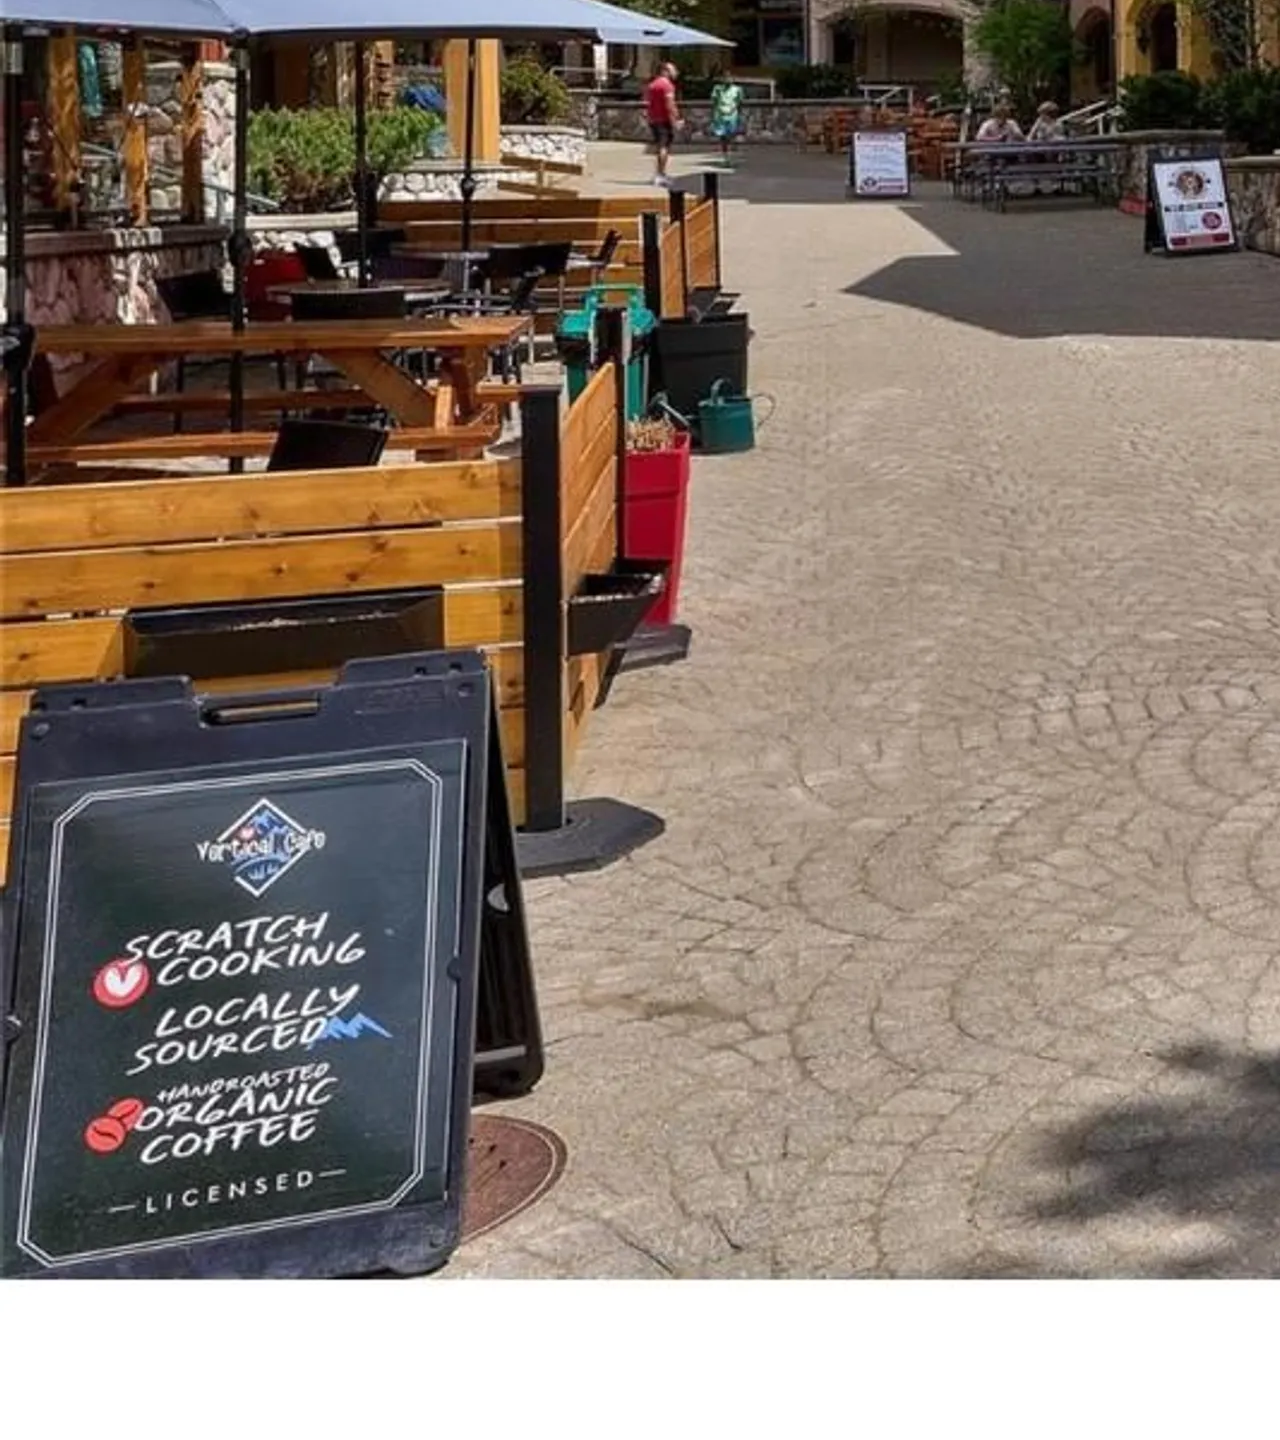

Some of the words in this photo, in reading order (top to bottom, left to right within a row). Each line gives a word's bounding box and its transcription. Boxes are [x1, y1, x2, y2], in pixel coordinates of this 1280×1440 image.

[122, 912, 329, 965] SCRATCH
[156, 933, 366, 986] COOKING
[155, 983, 360, 1038] LOCALLY
[126, 1018, 327, 1077] SOURCED
[135, 1078, 338, 1131] ORGANIC
[157, 1063, 331, 1102] HANDROASTED
[140, 1109, 320, 1164] COFFEE
[146, 1170, 314, 1214] LICENSED
